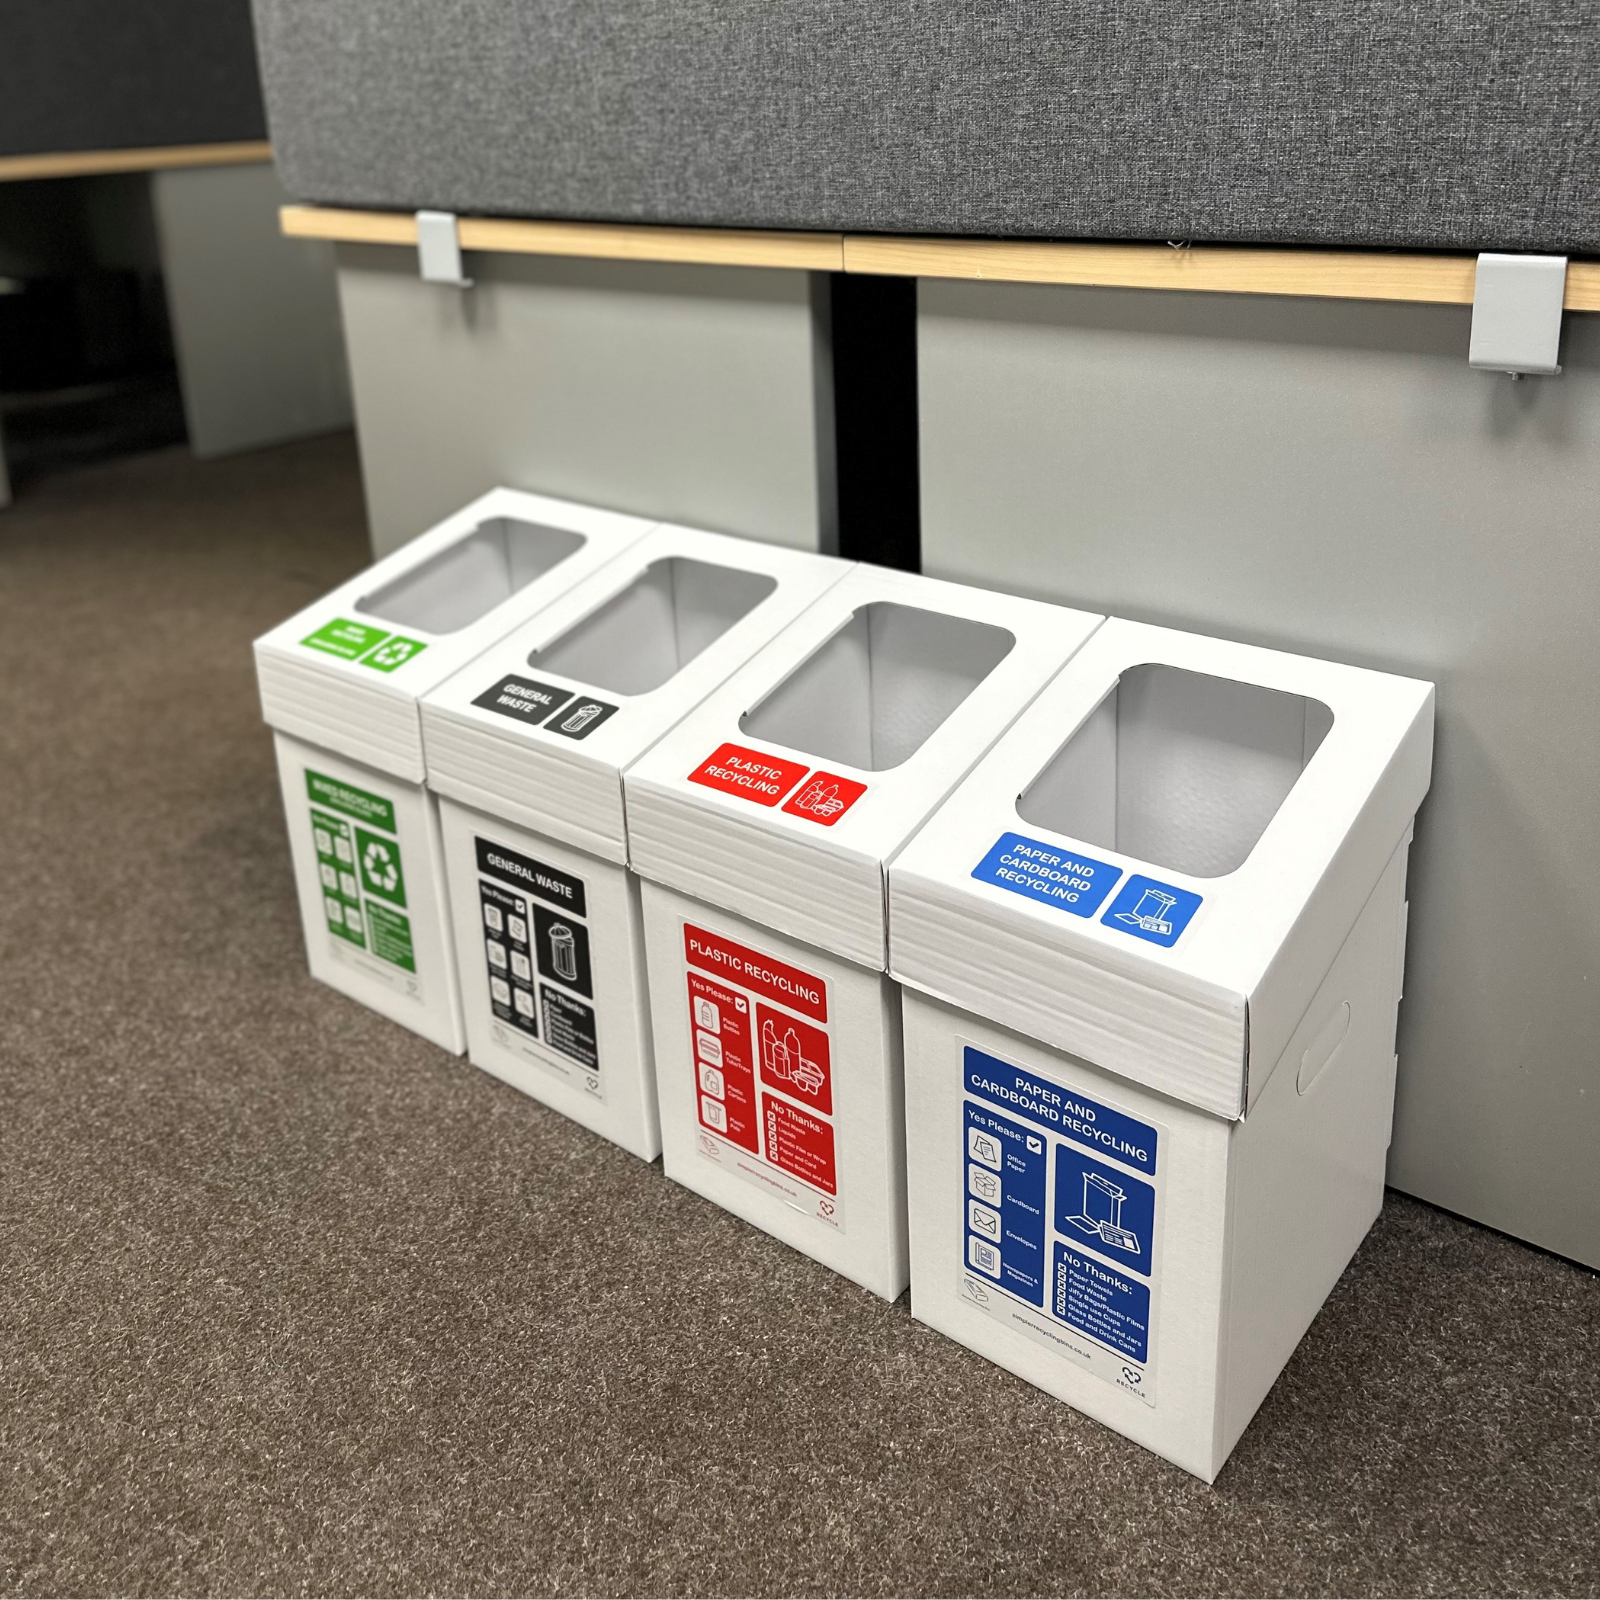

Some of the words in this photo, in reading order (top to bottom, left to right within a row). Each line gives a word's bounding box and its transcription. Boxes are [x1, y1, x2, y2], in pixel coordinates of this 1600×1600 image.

[497, 694, 537, 714] WASTE
[503, 683, 552, 706] GENERAL
[726, 756, 782, 780] PLASTIC
[704, 765, 780, 796] RECYCLING
[1000, 854, 1091, 892] CARDBOARD
[1013, 844, 1060, 867] PAPER
[1061, 860, 1094, 878] AND
[487, 853, 535, 882] GENERAL
[536, 874, 572, 899] WASTE
[996, 867, 1079, 904] RECYCLING
[690, 939, 741, 970] PLASTIC
[744, 962, 820, 1004] RECYCLING
[545, 989, 556, 1002] No
[691, 979, 704, 991] Yes
[706, 985, 734, 1004] Please:
[722, 1017, 739, 1028] Plastic
[724, 1024, 740, 1036] Bottles
[726, 1051, 741, 1062] Plastic
[728, 1084, 744, 1096] Plastic
[1015, 1077, 1060, 1107] PAPER
[1064, 1100, 1096, 1122] AND
[730, 1117, 746, 1128] Plastic
[771, 1101, 784, 1114] No
[786, 1108, 823, 1134] Thanks:
[778, 1118, 790, 1128] Food
[790, 1124, 806, 1135] Waste
[968, 1110, 986, 1125] Yes
[988, 1116, 1024, 1143] Please:
[971, 1074, 1059, 1122] CARDBOARD
[1062, 1114, 1148, 1162] RECYCLING
[779, 1127, 796, 1140] Liquids
[779, 1137, 795, 1148] Plastic
[796, 1146, 806, 1154] Film
[813, 1154, 826, 1164] Wrap
[780, 1146, 794, 1157] Paper
[804, 1160, 816, 1170] Card
[1006, 1154, 1026, 1168] Office
[780, 1156, 794, 1167] Glass
[794, 1164, 812, 1176] Bottles
[812, 1174, 822, 1182] and
[822, 1179, 834, 1188] Jars
[1007, 1160, 1026, 1174] Paper
[1006, 1194, 1040, 1215] Cardboard
[816, 1212, 838, 1228] RECYCLE
[1006, 1230, 1037, 1250] Envelopes
[1002, 1262, 1033, 1282] Newspapers
[1007, 1270, 1034, 1288] Magazines
[1064, 1252, 1080, 1268] No
[1084, 1262, 1132, 1295] Thanks:
[1069, 1269, 1088, 1283] Paper
[1090, 1280, 1113, 1296] Towels
[1068, 1278, 1085, 1290] Food
[1086, 1286, 1108, 1302] Waste
[1068, 1287, 1083, 1298] Jiffy
[1084, 1294, 1126, 1320] Bags/Plastic
[1126, 1317, 1144, 1330] Films
[1068, 1296, 1088, 1310] Single
[1090, 1308, 1102, 1317] use
[1103, 1314, 1121, 1327] Cups
[1012, 1313, 1092, 1360] simplerrecyclingbins.co.uk
[1068, 1304, 1086, 1318] Glass
[1088, 1314, 1112, 1330] Bottles
[1112, 1328, 1126, 1338] and
[1126, 1336, 1142, 1347] Jars
[1068, 1312, 1084, 1324] Food
[1085, 1322, 1098, 1332] and
[1099, 1329, 1117, 1342] Drink
[1118, 1340, 1136, 1352] Cans
[1116, 1378, 1146, 1398] RECYCLE
